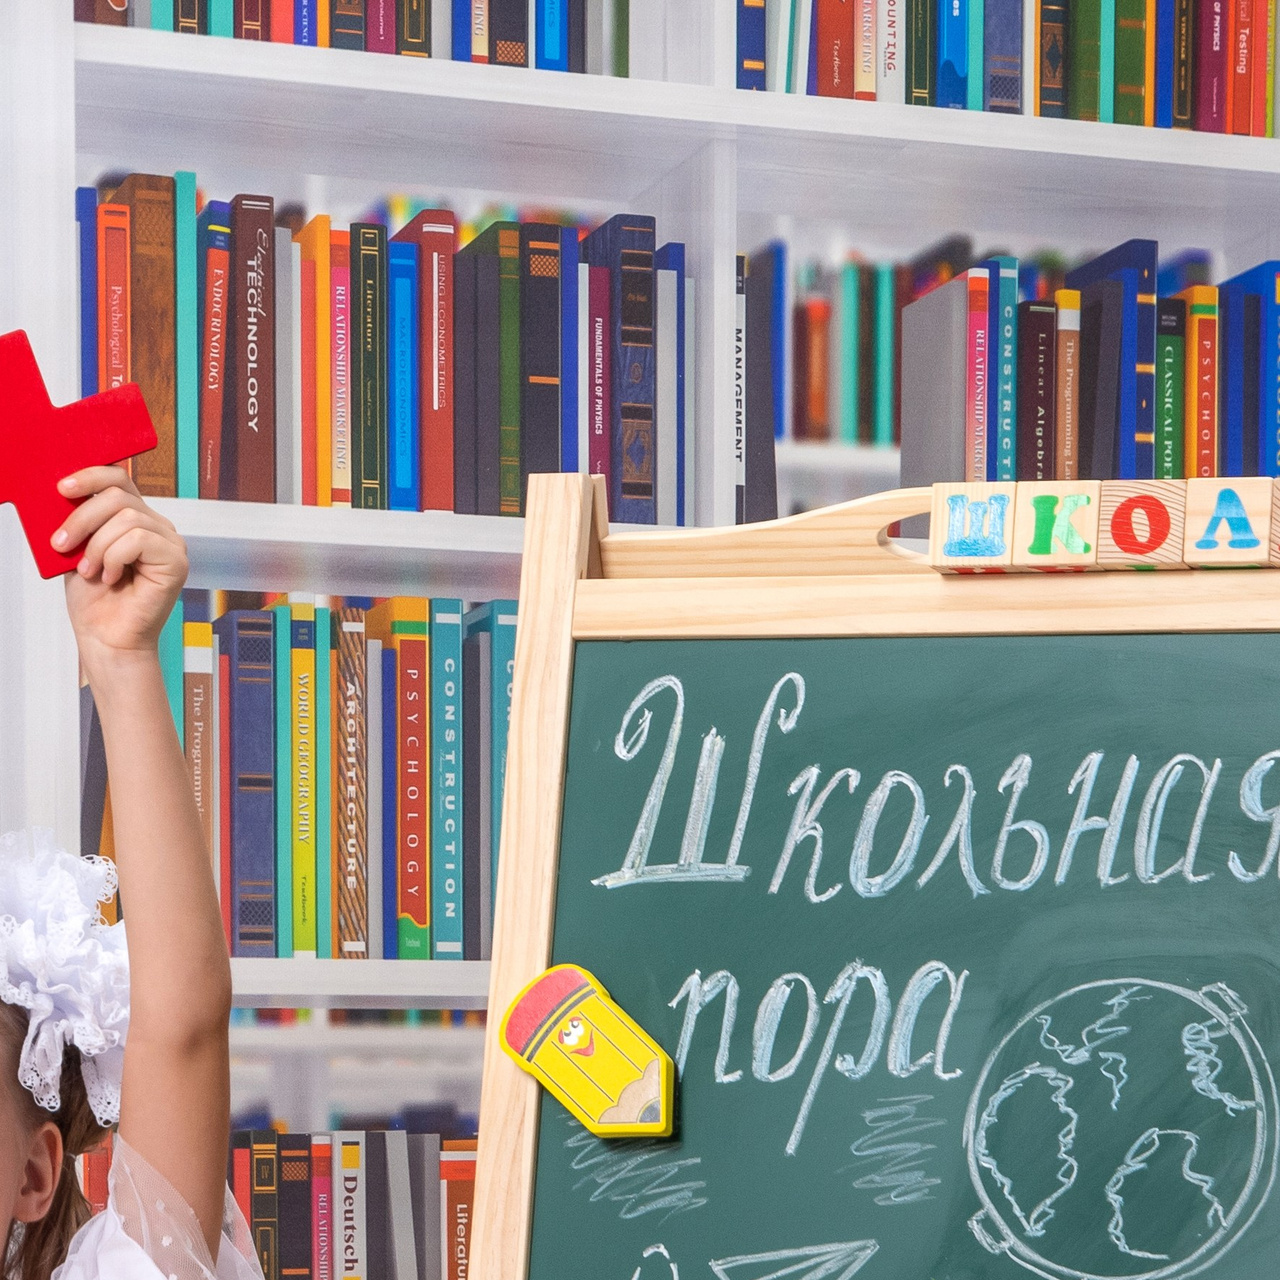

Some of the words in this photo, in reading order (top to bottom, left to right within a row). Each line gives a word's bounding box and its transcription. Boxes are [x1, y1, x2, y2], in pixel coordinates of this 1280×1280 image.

[1213, 15, 1221, 51] PHYSICS
[1214, 2, 1221, 13] OF
[1236, 27, 1250, 74] Testing
[832, 38, 841, 88] Textbook
[256, 227, 269, 317] Electrical
[438, 254, 446, 296] USING
[110, 285, 124, 367] Psychological
[207, 268, 224, 392] ENDOCRINOLOGY
[247, 256, 259, 433] TECHNOLOGY
[335, 285, 346, 384] RELATIONSHIP
[366, 279, 374, 352] Literature
[438, 300, 446, 409] ECONOMETRICS
[595, 317, 604, 385] FUNDAMENTALS
[1066, 339, 1074, 364] The
[398, 316, 408, 457] MACROECONOMICS
[595, 386, 603, 397] OF
[974, 329, 985, 422] RELATIONSHIP
[1003, 305, 1013, 480] CONSTRUCTI
[1038, 333, 1047, 397] Linear
[1164, 345, 1173, 436] CLASSICAL
[336, 386, 347, 470] MARKETING
[595, 398, 603, 435] PHYSICS
[1035, 406, 1046, 480] Algebra
[1064, 368, 1074, 456] Programming
[1202, 340, 1211, 477] PSYCHOLO
[973, 425, 984, 480] MARKET
[1164, 440, 1173, 479] POET
[943, 488, 1261, 556] ШКОЛ
[193, 684, 204, 719] The
[298, 673, 310, 735] WORLD
[192, 721, 203, 812] Programm
[298, 738, 310, 845] GEOGRAPHY
[346, 681, 357, 890] ARCHITECTURE
[407, 668, 419, 897] PSYCHOLOGY
[444, 657, 456, 918] CONSTRUCTION
[591, 672, 1280, 902] Школьная
[668, 959, 970, 1156] пора
[344, 1175, 359, 1272] Deutsch
